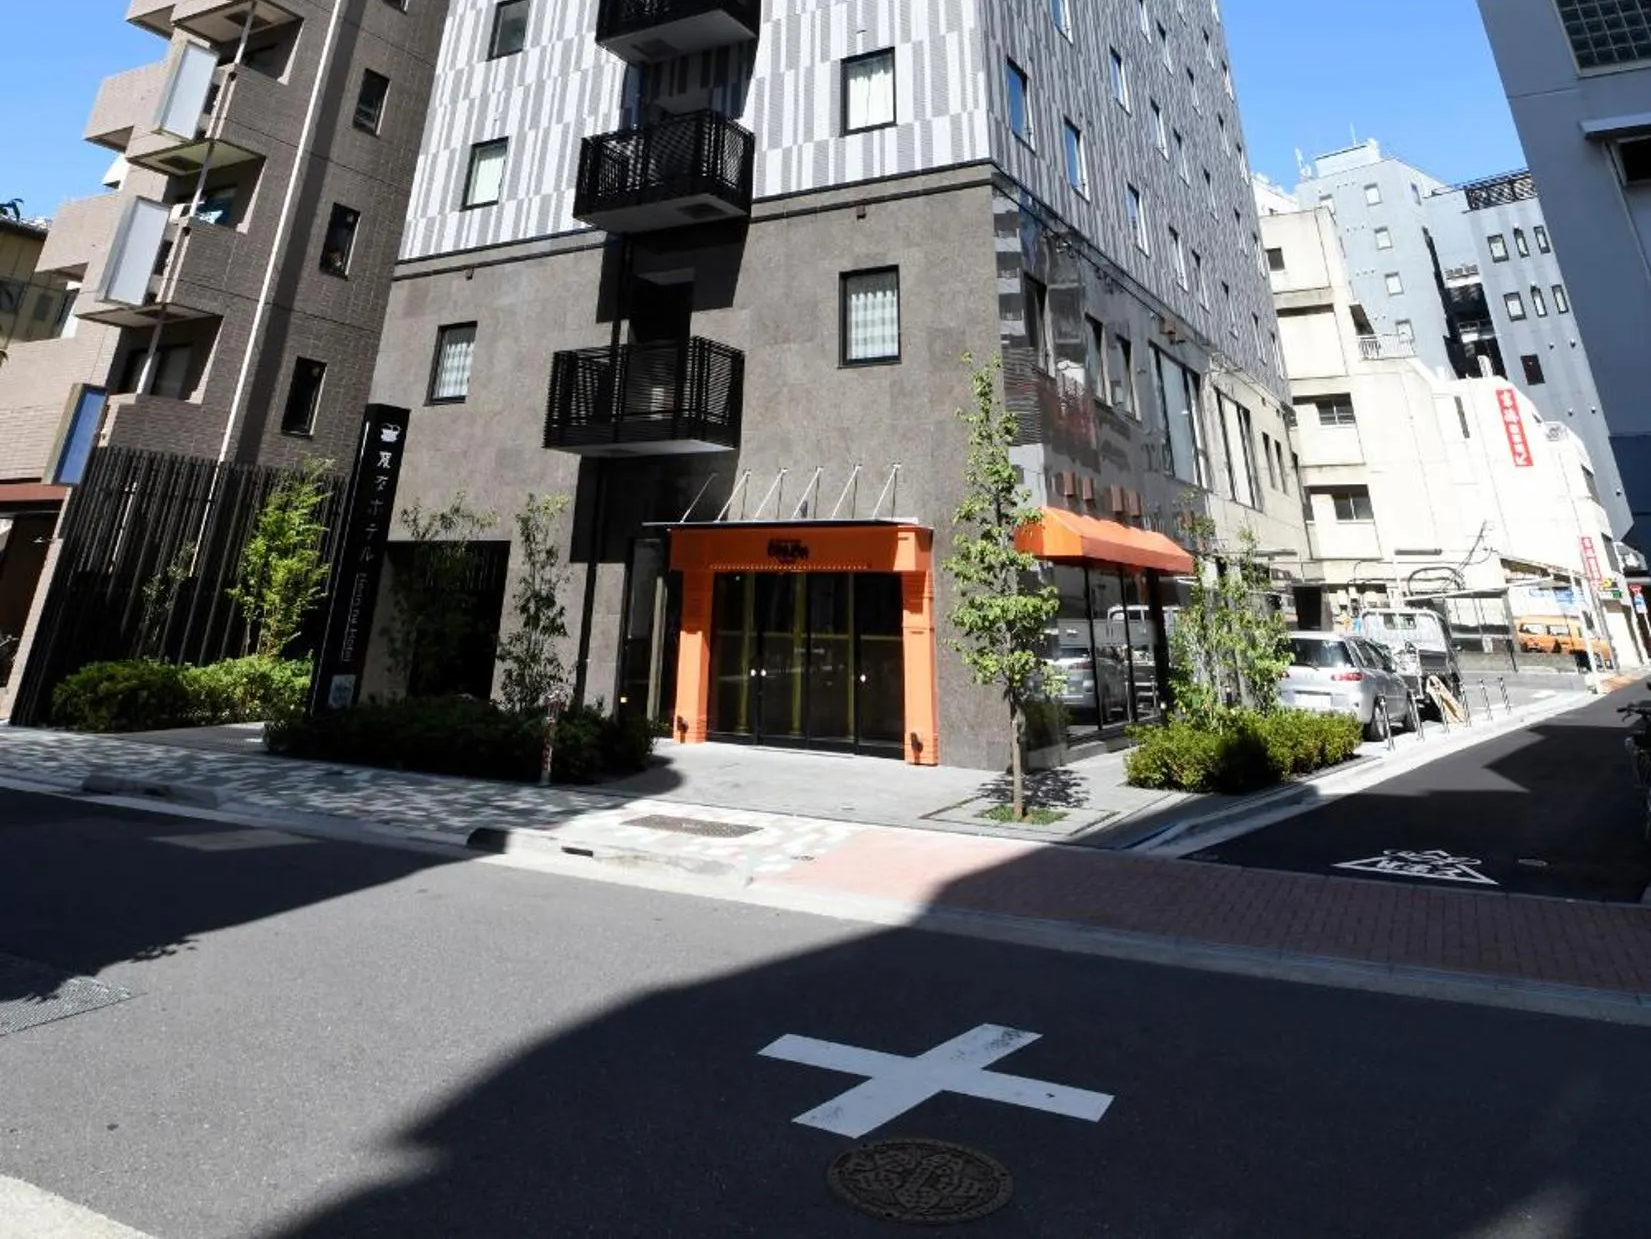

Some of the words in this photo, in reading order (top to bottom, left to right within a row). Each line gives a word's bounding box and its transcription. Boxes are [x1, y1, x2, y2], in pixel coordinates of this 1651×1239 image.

[359, 451, 392, 562] 変なホテル
